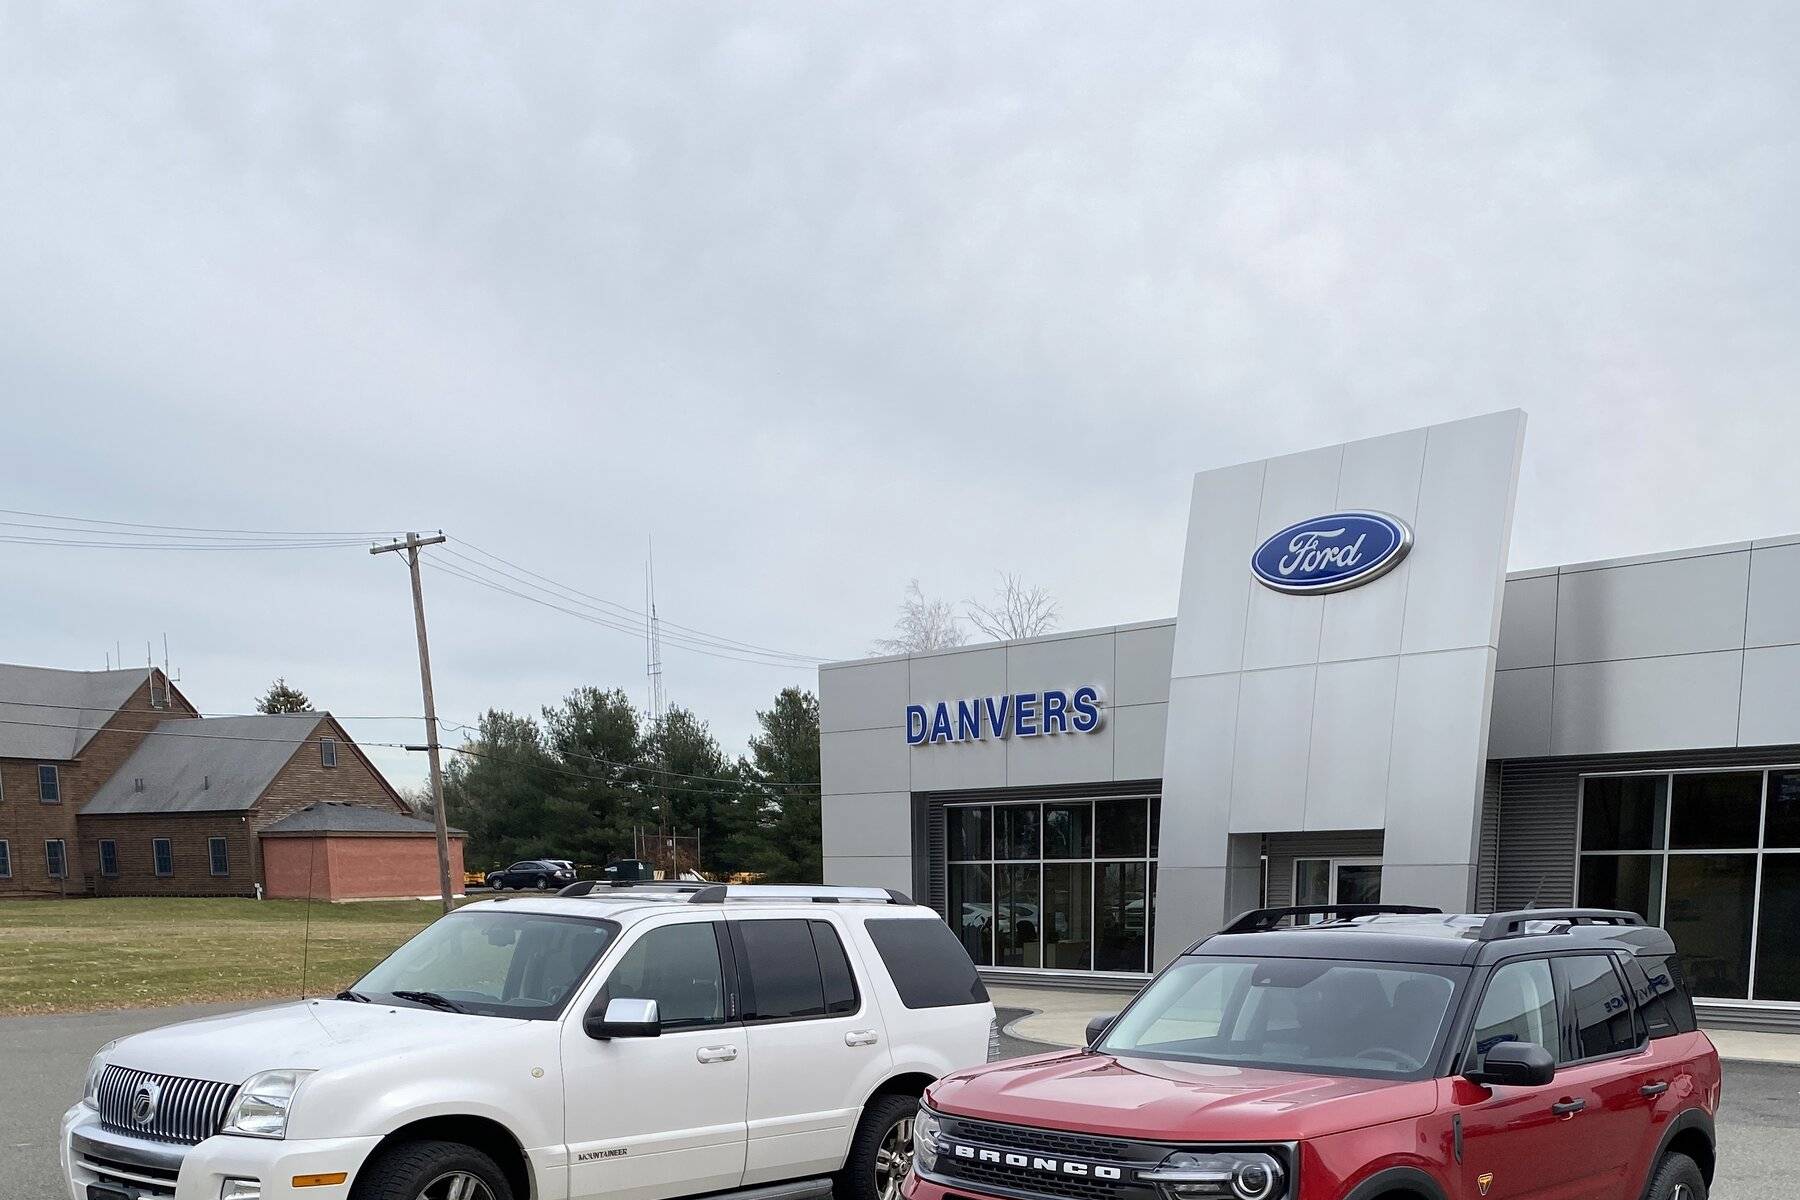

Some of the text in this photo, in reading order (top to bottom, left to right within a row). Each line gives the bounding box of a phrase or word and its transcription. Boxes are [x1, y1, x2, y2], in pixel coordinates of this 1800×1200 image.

[1278, 527, 1367, 576] Ford
[906, 686, 1101, 745] DANVERS
[578, 1148, 628, 1161] MOUNTAINEER
[955, 1144, 1121, 1180] BRONCO
